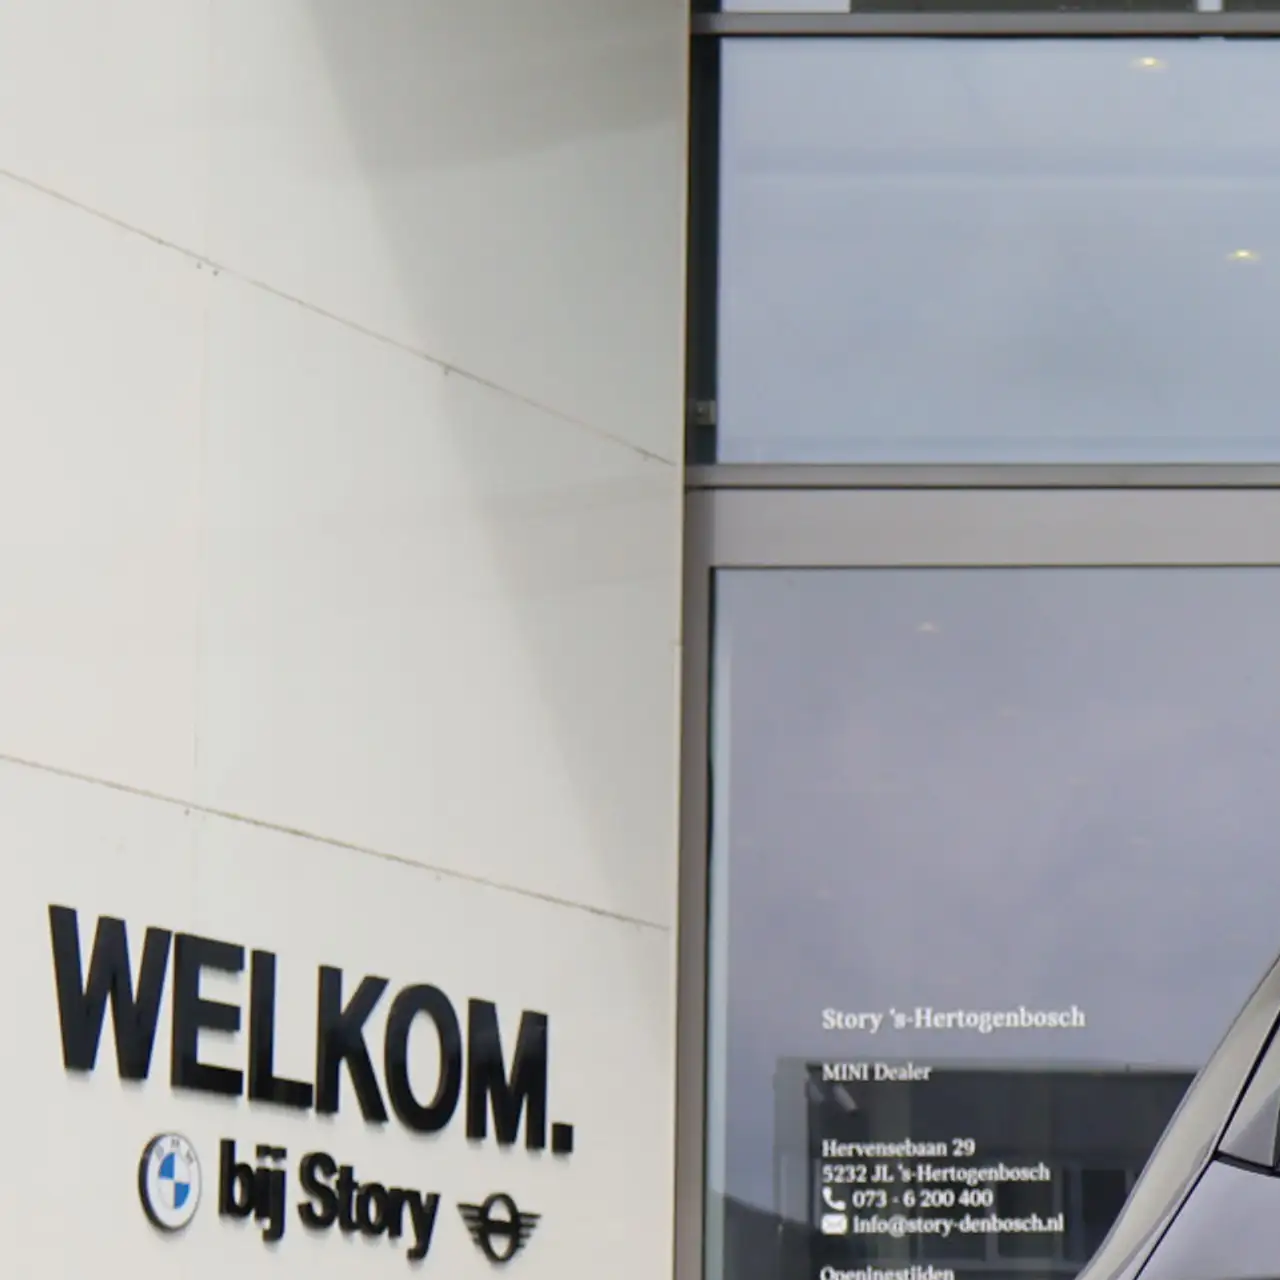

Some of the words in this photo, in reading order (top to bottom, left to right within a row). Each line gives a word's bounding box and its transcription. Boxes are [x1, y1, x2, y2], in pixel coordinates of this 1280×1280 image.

[48, 903, 575, 1154] WELKOM.
[821, 1008, 883, 1033] Story
[889, 1006, 1086, 1033] 's-Hertogenbosch
[822, 1063, 869, 1080] MINI
[874, 1063, 932, 1081] Dealer
[952, 1138, 976, 1156] 29
[822, 1164, 867, 1182] 5232
[899, 1162, 1051, 1185] 's-Hertogenbosch
[217, 1138, 288, 1242] bij
[297, 1151, 442, 1261] Story
[852, 1190, 887, 1207] 073
[902, 1190, 916, 1207] 6
[919, 1190, 955, 1207] 200
[958, 1189, 994, 1207] 400
[852, 1213, 1064, 1237] info@story-denbosch.nl
